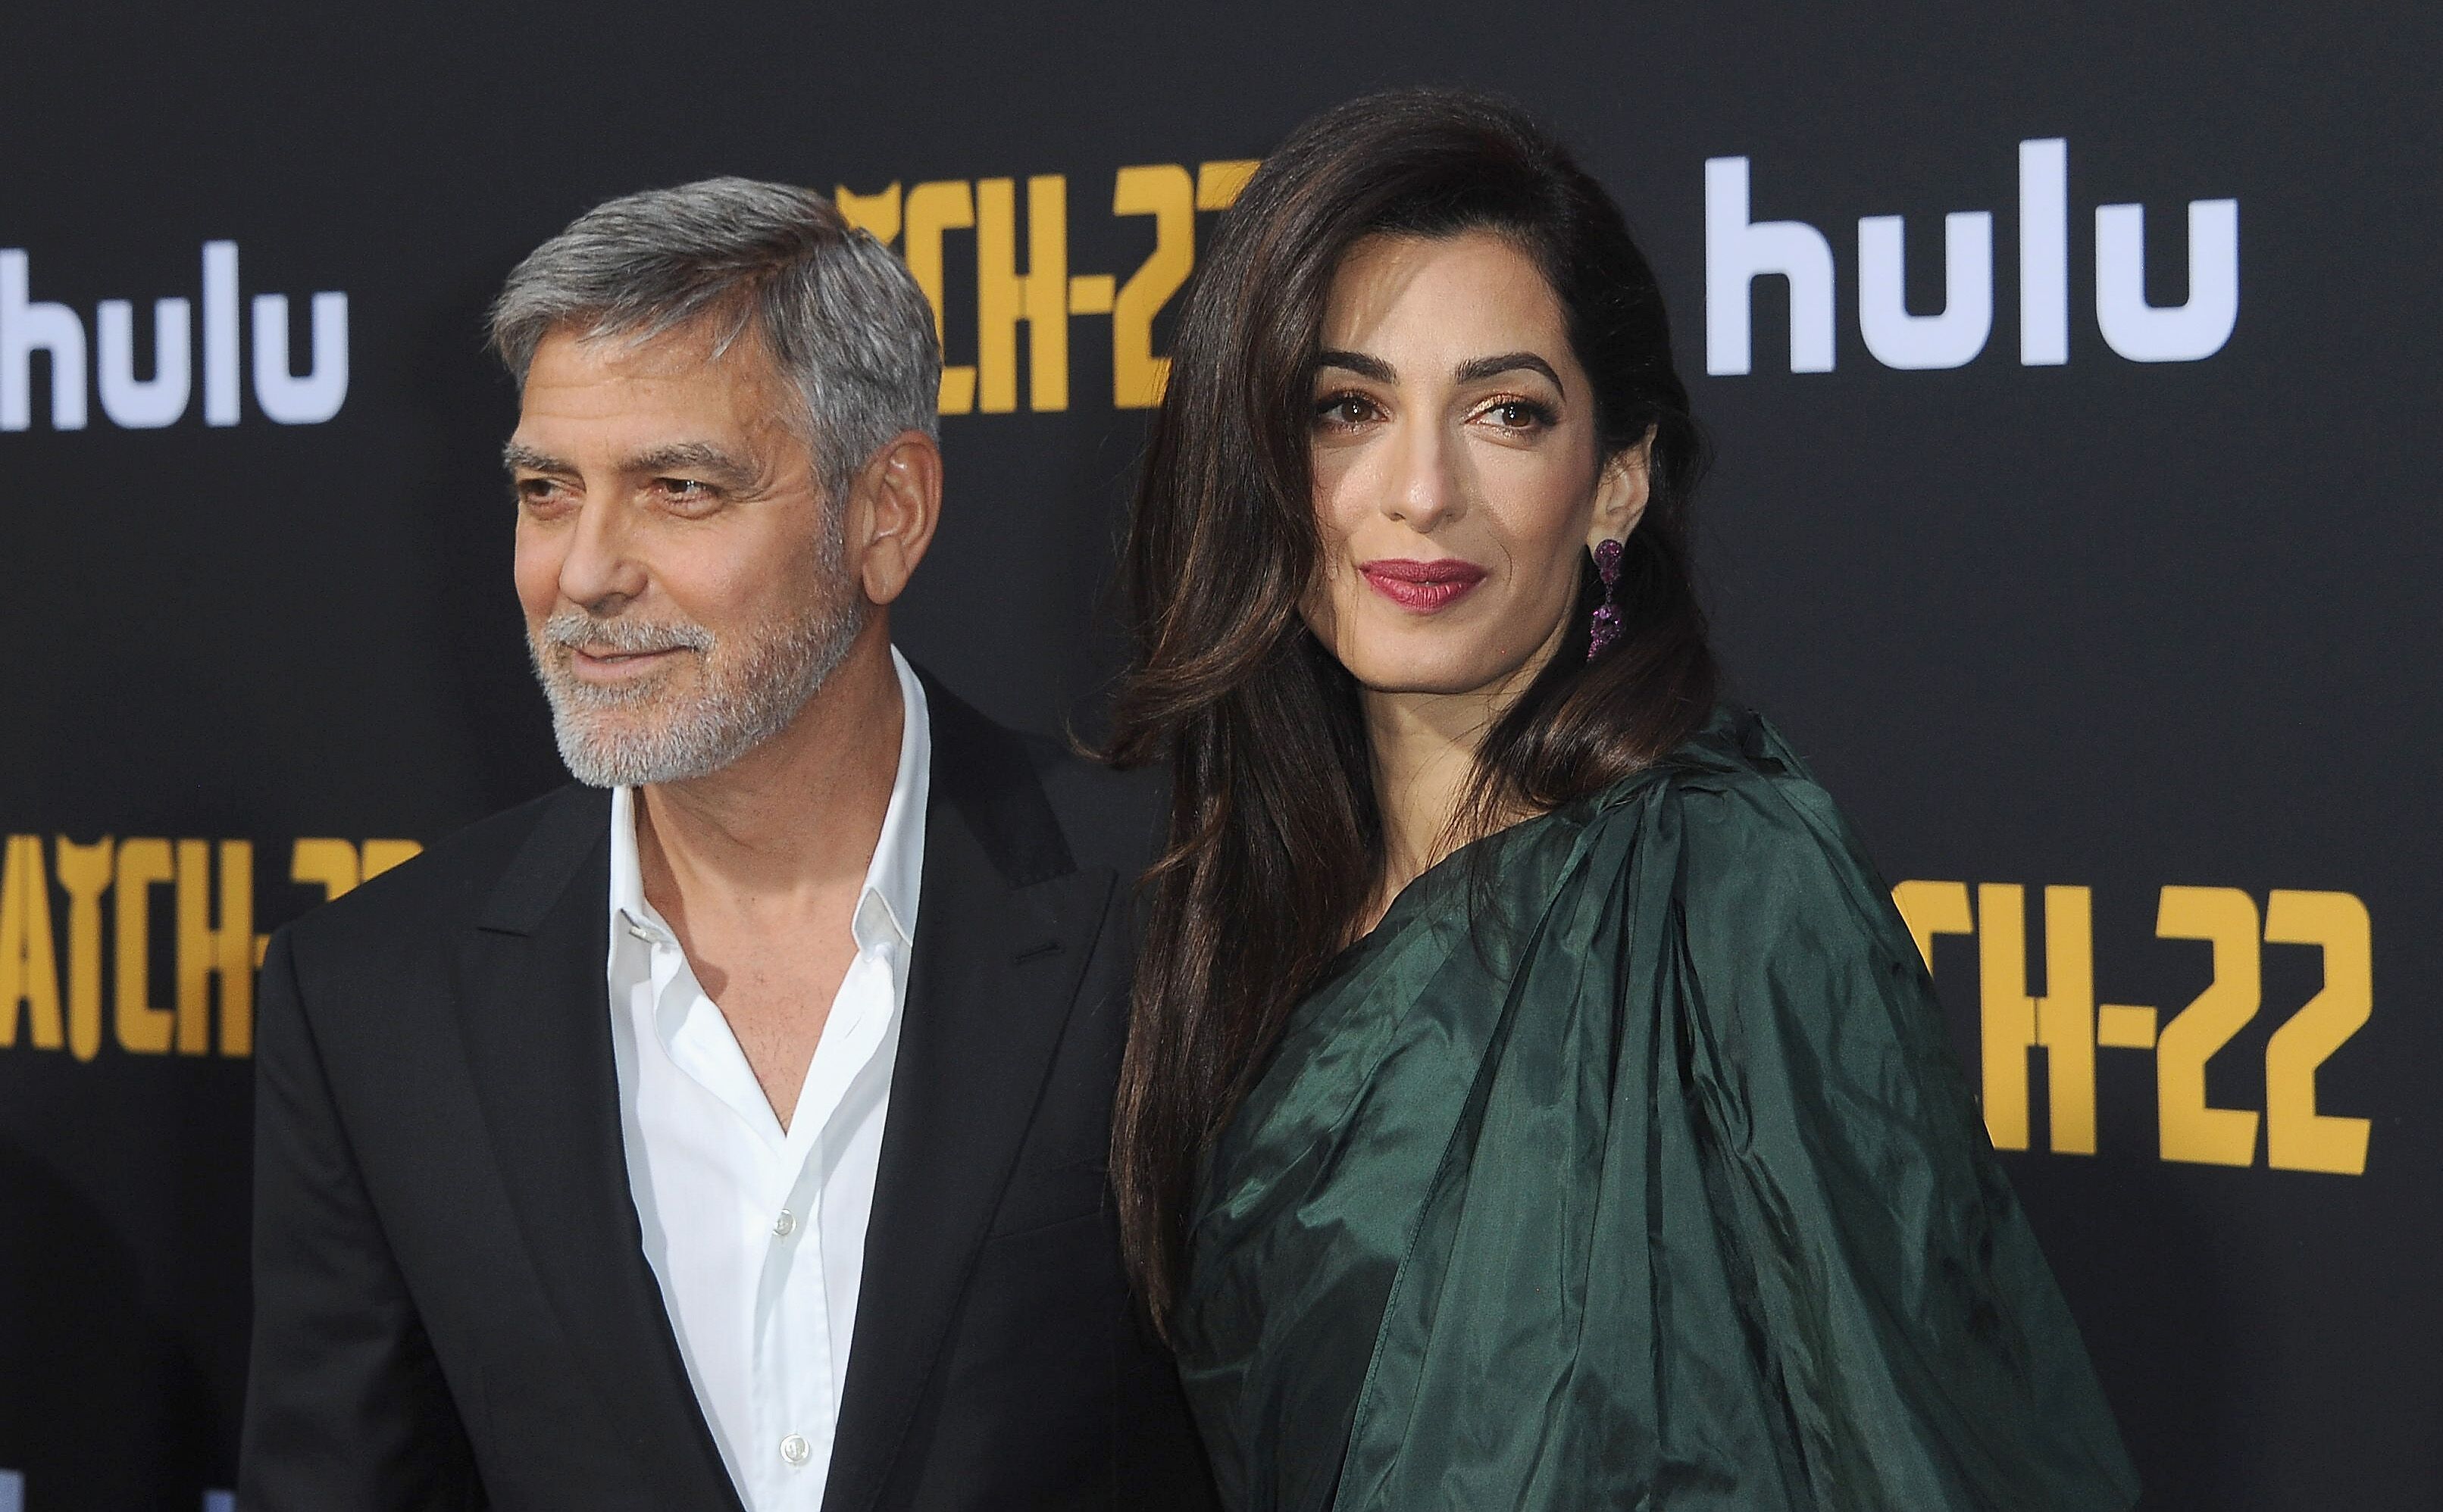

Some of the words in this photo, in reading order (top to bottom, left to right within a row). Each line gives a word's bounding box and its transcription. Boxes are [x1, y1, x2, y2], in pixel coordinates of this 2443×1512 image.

[0, 239, 349, 432] hulu
[835, 160, 1262, 415] CH-2
[1705, 137, 2239, 375] hulu
[0, 834, 424, 1062] ATCH
